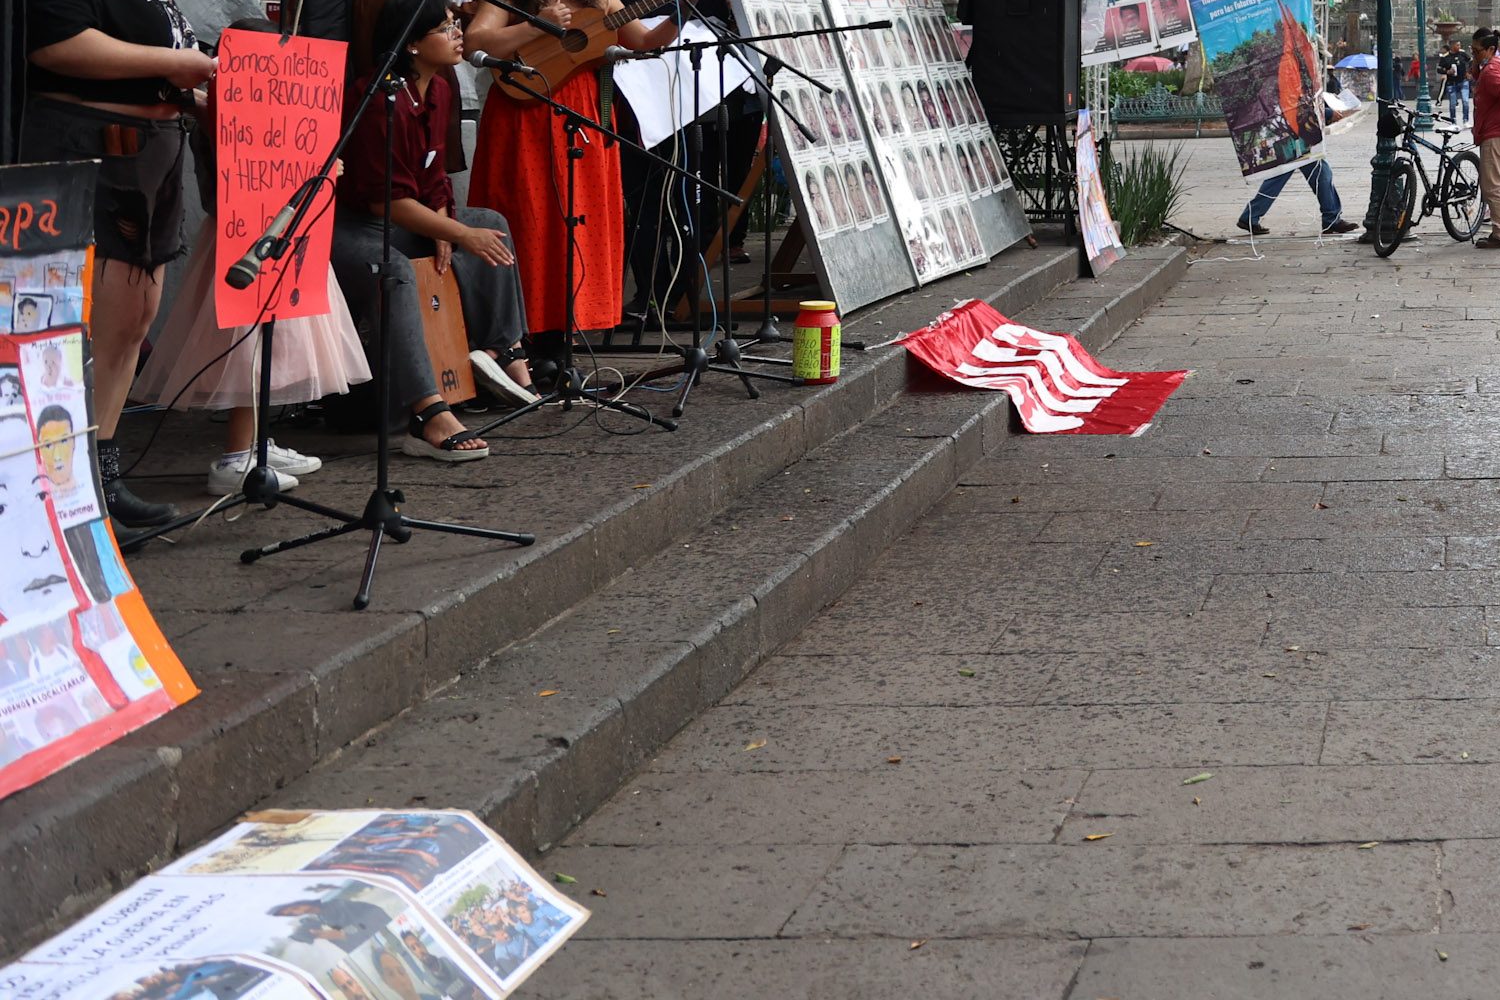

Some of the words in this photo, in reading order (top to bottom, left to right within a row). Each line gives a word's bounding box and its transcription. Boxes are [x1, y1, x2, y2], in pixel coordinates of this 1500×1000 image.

[1209, 8, 1225, 21] para
[1224, 4, 1234, 13] las
[219, 34, 279, 76] Somos
[283, 42, 329, 79] nietas
[223, 77, 244, 102] de
[250, 76, 263, 103] la
[268, 78, 343, 115] REVOLUCIÓN
[220, 113, 253, 163] hijas
[263, 116, 287, 148] del
[294, 117, 318, 155] 68
[221, 167, 230, 204] y
[225, 210, 248, 239] de
[38, 675, 85, 703] LOCALIZARLO
